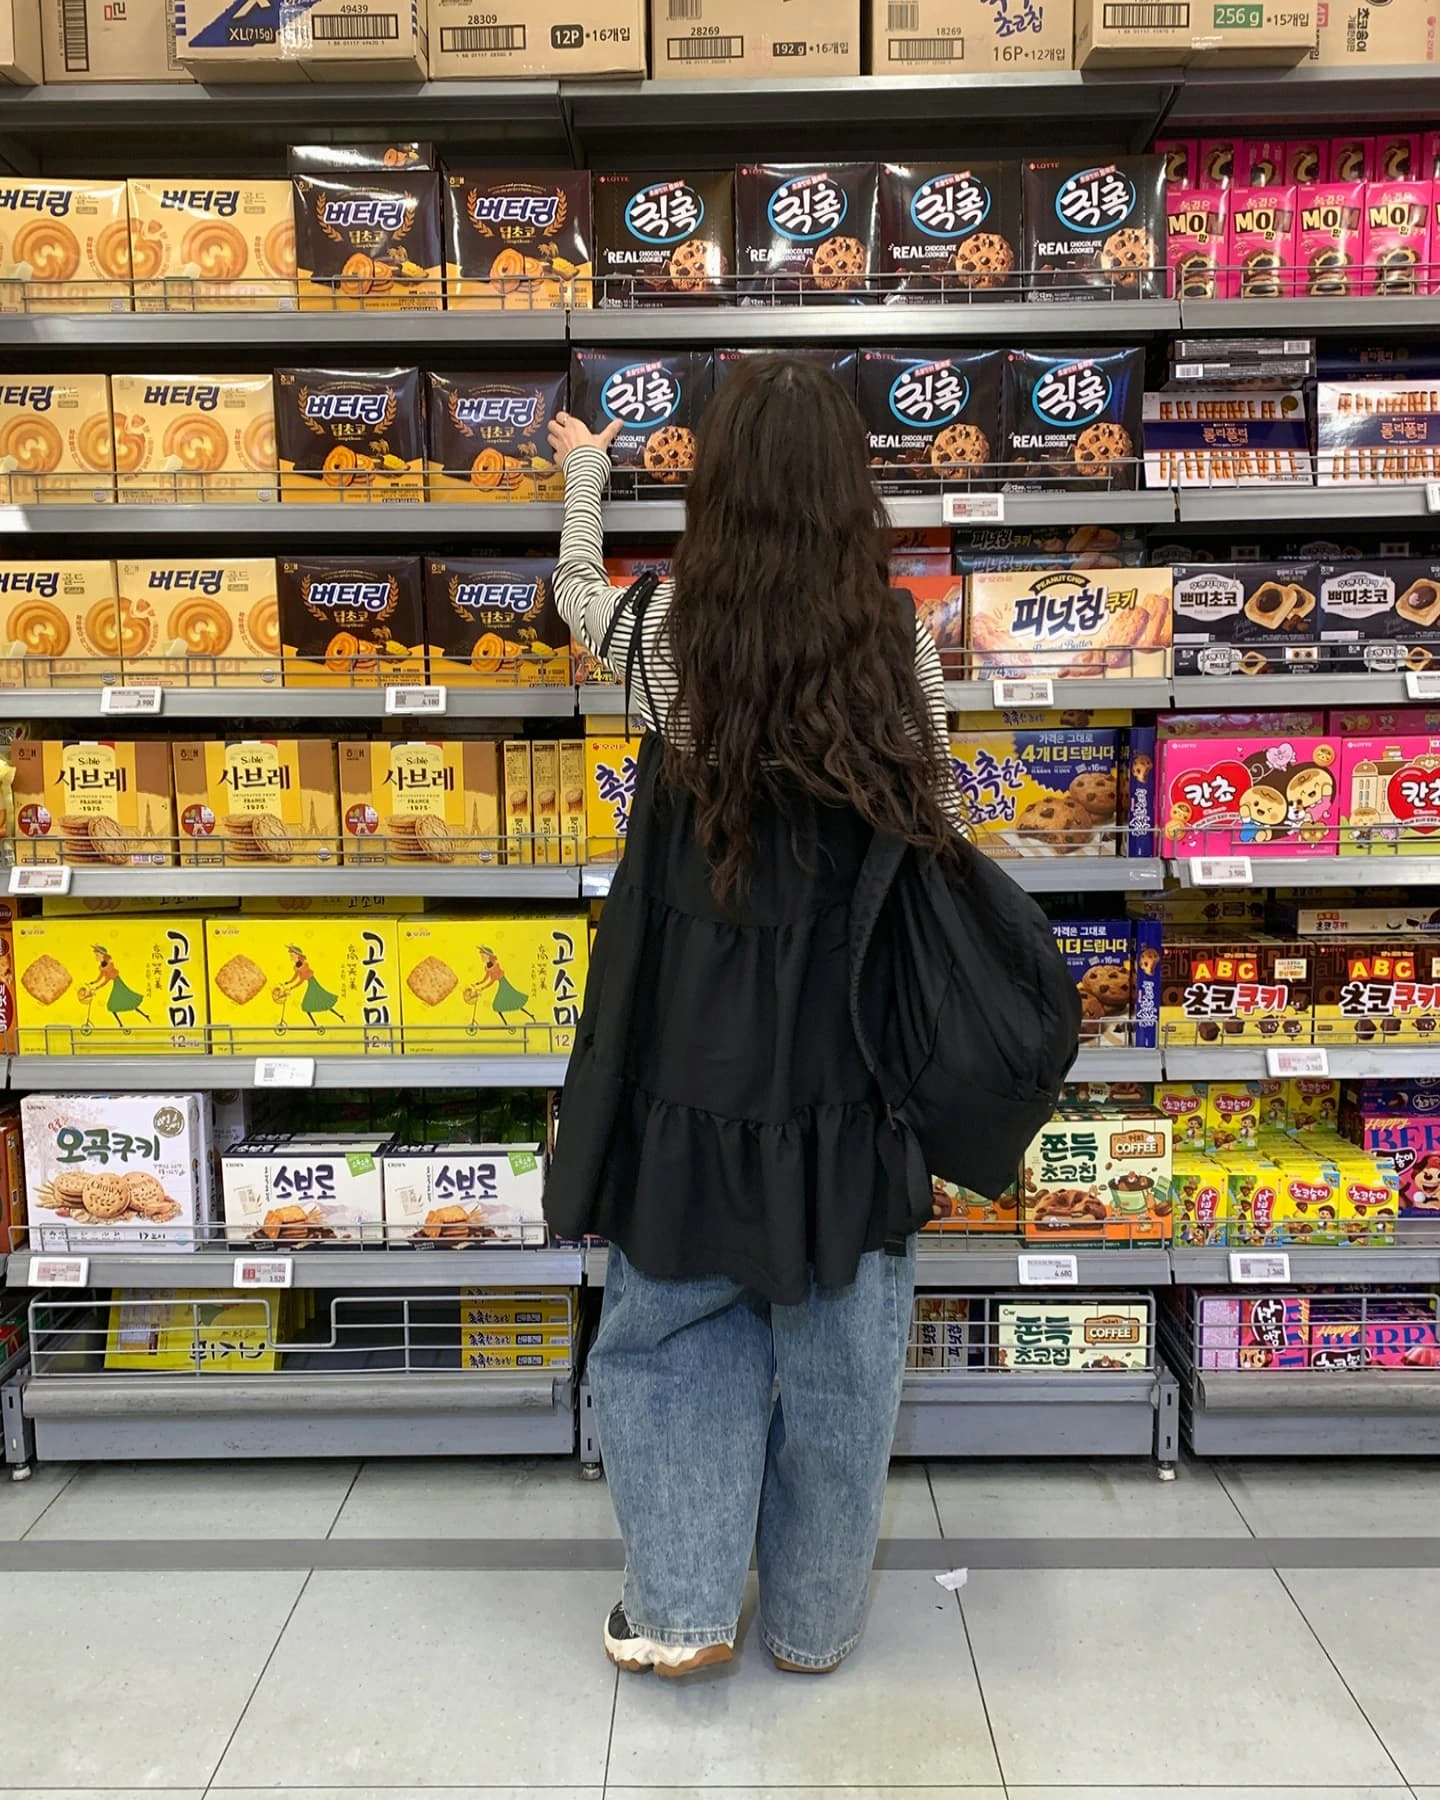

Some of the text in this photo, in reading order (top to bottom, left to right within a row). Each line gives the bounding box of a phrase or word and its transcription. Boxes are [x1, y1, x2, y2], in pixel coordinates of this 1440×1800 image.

[340, 4, 369, 13] 49439
[468, 15, 498, 25] 28309
[1215, 8, 1260, 27] 256 g
[229, 27, 273, 42] XL(715g)
[554, 30, 580, 45] 12P
[690, 27, 720, 36] 28269
[937, 27, 962, 36] 18269
[1356, 8, 1370, 52] 초코송이
[1036, 162, 1060, 170] LOTTE
[160, 189, 240, 218] 버터링
[475, 196, 559, 227] 버터링
[772, 183, 841, 234] 칙촉
[915, 181, 985, 231] 칙촉
[1060, 175, 1130, 226] 칙촉
[325, 199, 406, 231] 버터링
[630, 189, 699, 238] 칙촉
[499, 225, 536, 241] 딥초코
[607, 251, 639, 264] REAL
[893, 246, 925, 259] REAL
[1038, 241, 1071, 256] REAL
[0, 384, 54, 412] 터링
[144, 384, 221, 412] 버터링
[606, 371, 675, 422] 칙촉
[894, 369, 964, 421] 칙촉
[1037, 369, 1107, 420] 칙촉
[305, 394, 389, 425] 버터링
[456, 396, 538, 427] 버터링
[329, 422, 367, 438] 딥초코
[479, 426, 514, 440] 딥초코
[1013, 434, 1045, 449] REAL
[870, 435, 902, 449] REAL
[148, 569, 250, 596] 버터링 골드
[1035, 573, 1087, 592] PEANUT CHIP
[309, 582, 391, 613] 버터링
[457, 582, 539, 613] 버터링
[1179, 590, 1238, 607] 쁘띠초코
[1327, 589, 1389, 606] 쁘띠초코
[333, 610, 369, 624] 딥초코
[480, 611, 514, 625] 딥초코
[1011, 587, 1138, 637] 피넛칩 쿠키
[1039, 733, 1094, 744] 가격은 그대로
[1020, 744, 1115, 763] 4개 더 드립니다
[55, 766, 127, 793] 사브레
[218, 765, 290, 791] 사브레
[384, 765, 454, 791] 사브레
[1183, 775, 1237, 808] 칸초
[968, 795, 1016, 825] 초코칩
[1052, 926, 1107, 937] 가격은 그대로
[1082, 938, 1128, 953] 드립니다
[167, 931, 196, 1028] 고소미
[362, 931, 389, 1026] 고소미
[552, 931, 580, 1026] 고소미
[1195, 958, 1255, 981] ABC
[1351, 957, 1413, 980] ABC
[1184, 984, 1287, 1017] 초코쿠키
[1341, 983, 1440, 1017] 초코쿠키
[1161, 1096, 1199, 1109] 초코송이
[1215, 1096, 1251, 1109] 초코송이
[1365, 1118, 1411, 1132] Happy
[56, 1127, 160, 1165] 오곡쿠키
[1040, 1132, 1099, 1162] 쫀득
[1115, 1142, 1157, 1154] COFFEE
[273, 1164, 336, 1200] 소보로
[435, 1163, 498, 1200] 소보로
[1040, 1163, 1097, 1184] 초코칩
[1288, 1183, 1331, 1200] 초코송이
[1348, 1185, 1389, 1204] 초코송이
[1014, 1315, 1073, 1345] 쫀득
[1089, 1328, 1132, 1339] COFFEE
[1014, 1346, 1070, 1366] 초코칩
